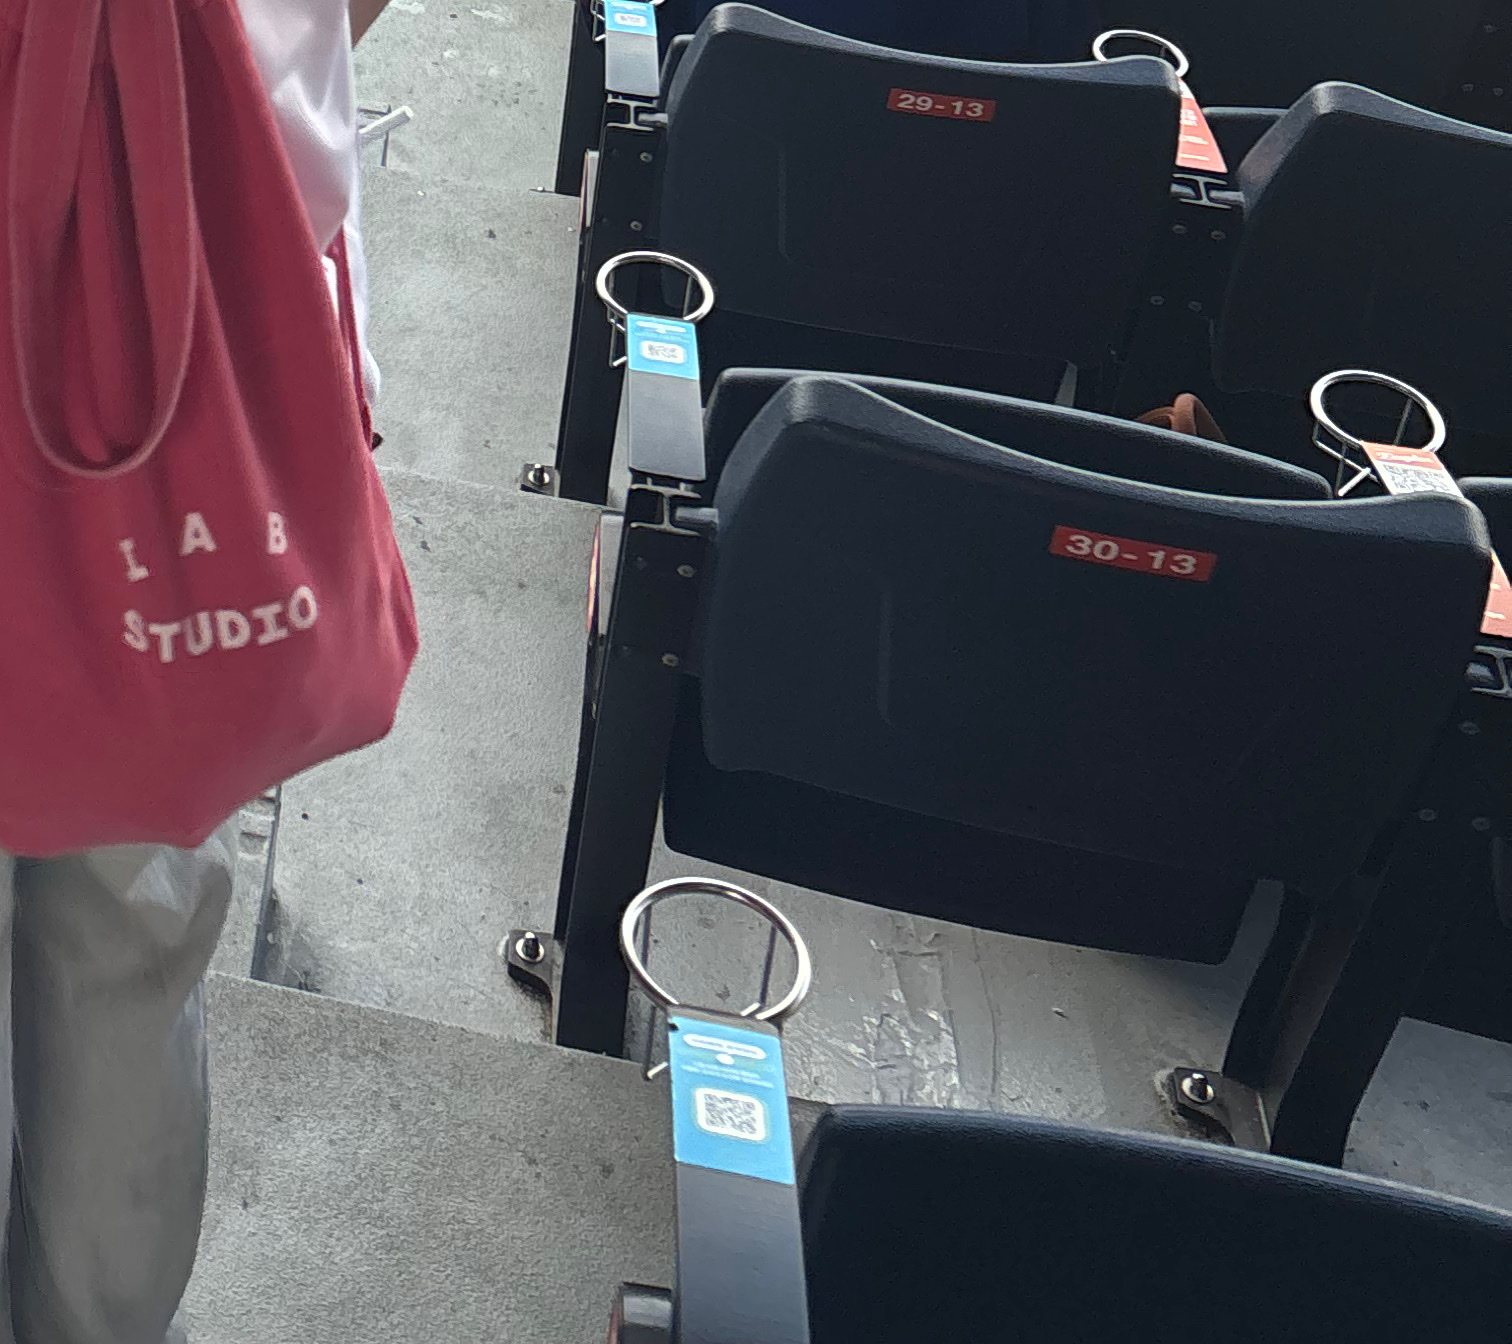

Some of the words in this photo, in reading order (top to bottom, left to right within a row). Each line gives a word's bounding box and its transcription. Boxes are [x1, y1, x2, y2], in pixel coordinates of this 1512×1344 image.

[896, 91, 986, 119] 29-13
[1064, 533, 1199, 576] 30-13
[123, 585, 318, 664] STUDIO
